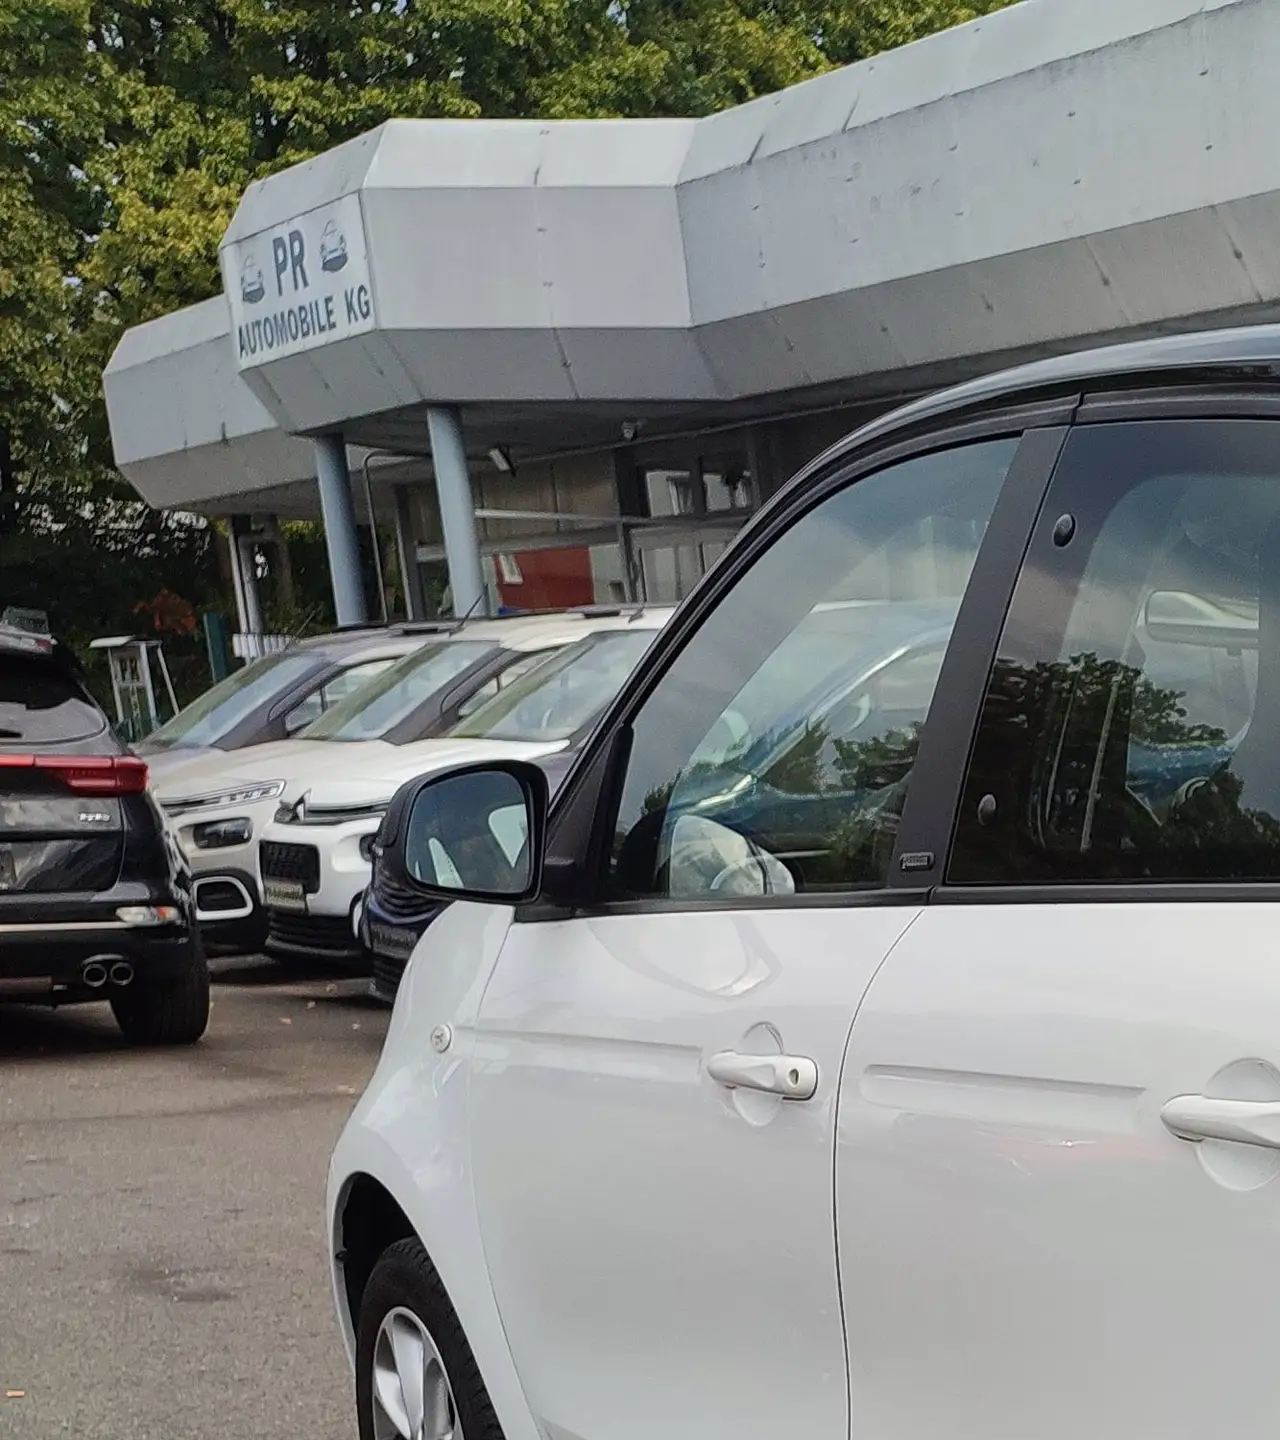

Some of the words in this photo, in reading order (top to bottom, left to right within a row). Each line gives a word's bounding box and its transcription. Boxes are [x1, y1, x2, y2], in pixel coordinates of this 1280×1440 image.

[272, 229, 309, 296] PR
[238, 296, 336, 359] AUTOMOBILE
[344, 284, 371, 326] KG
